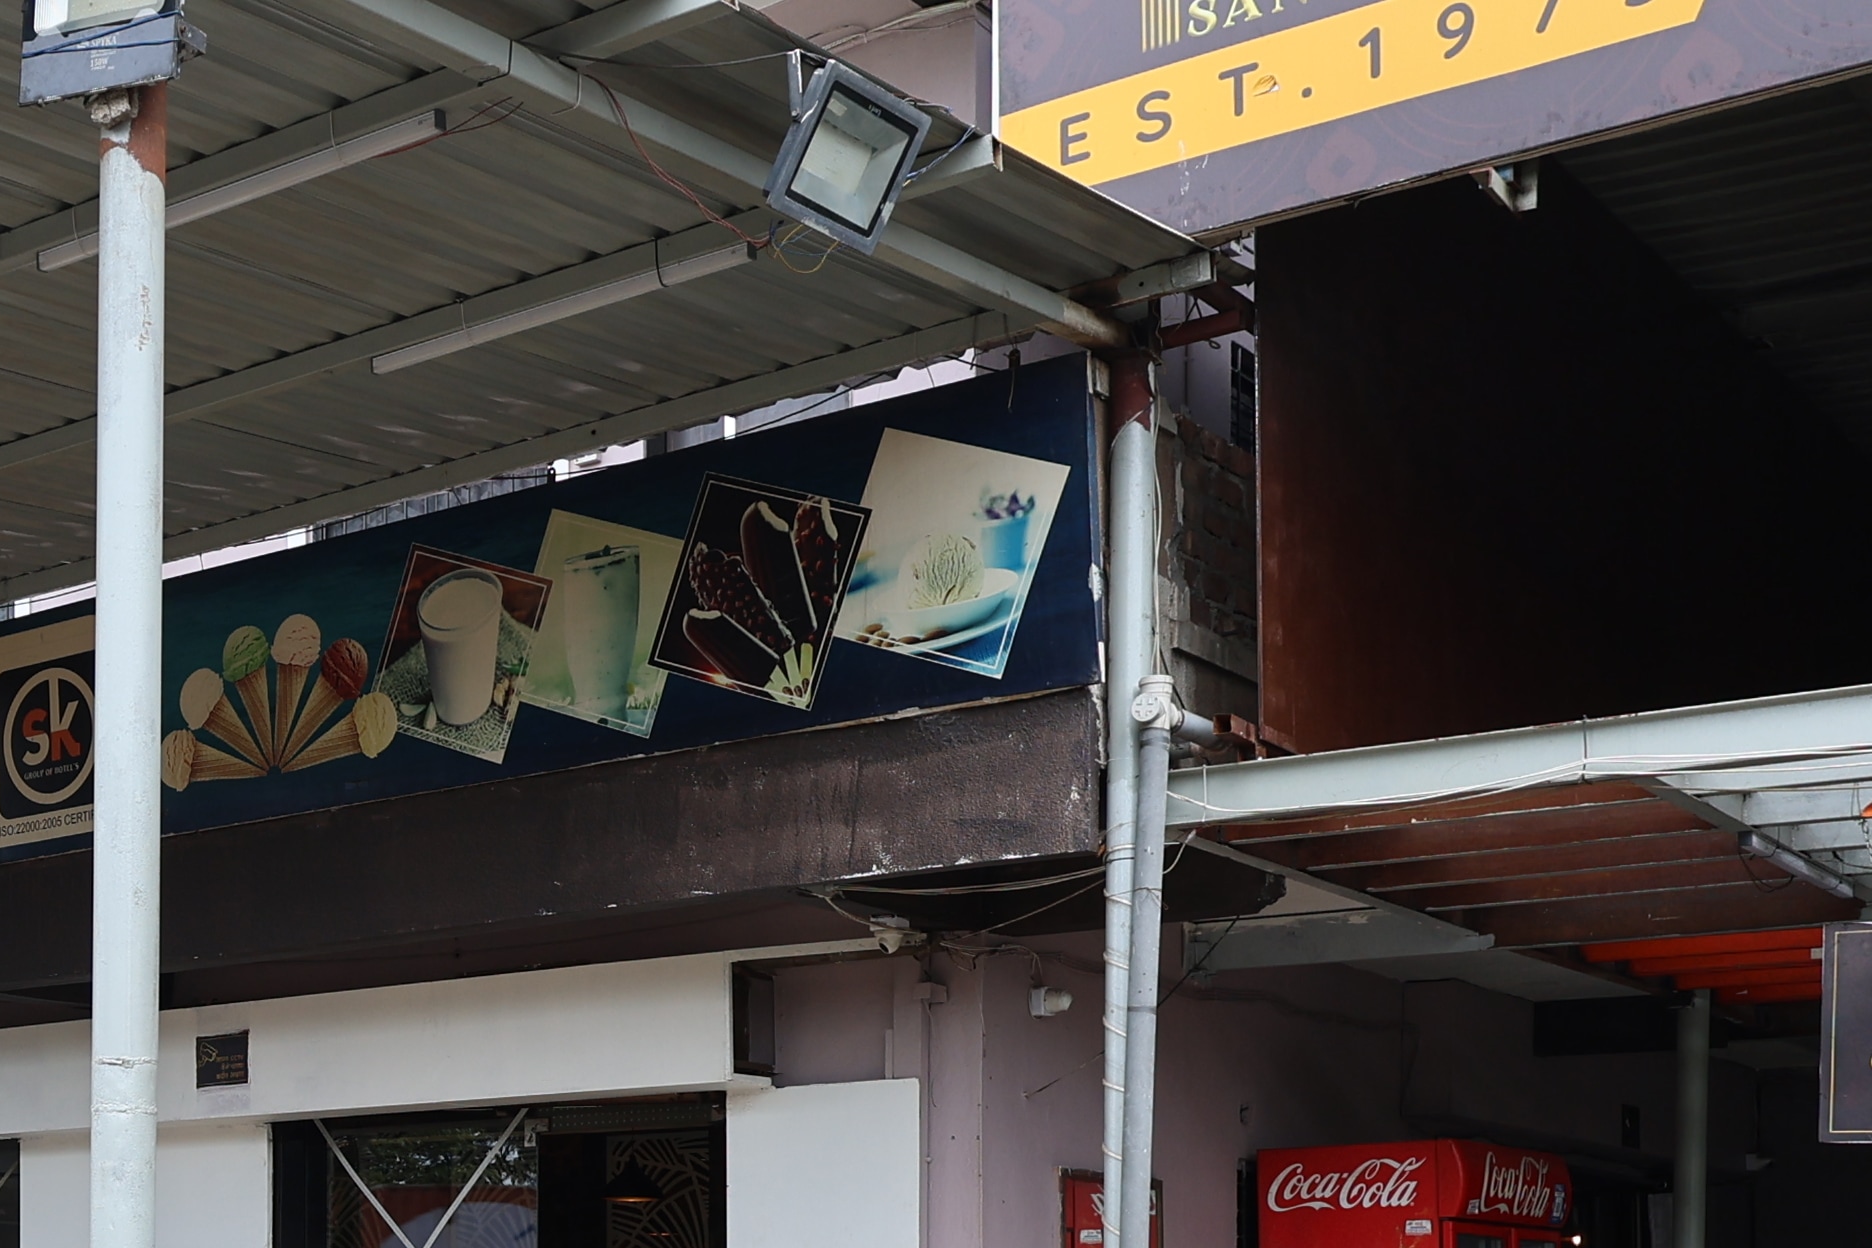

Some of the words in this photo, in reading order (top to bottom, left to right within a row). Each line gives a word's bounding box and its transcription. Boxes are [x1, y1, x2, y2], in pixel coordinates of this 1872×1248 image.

[22, 679, 81, 766] SK
[45, 767, 53, 777] OF
[0, 815, 62, 838] ISO:22000:2005
[1267, 1156, 1427, 1212] Coca-Cola
[1480, 1151, 1550, 1218] Coca-Cola
